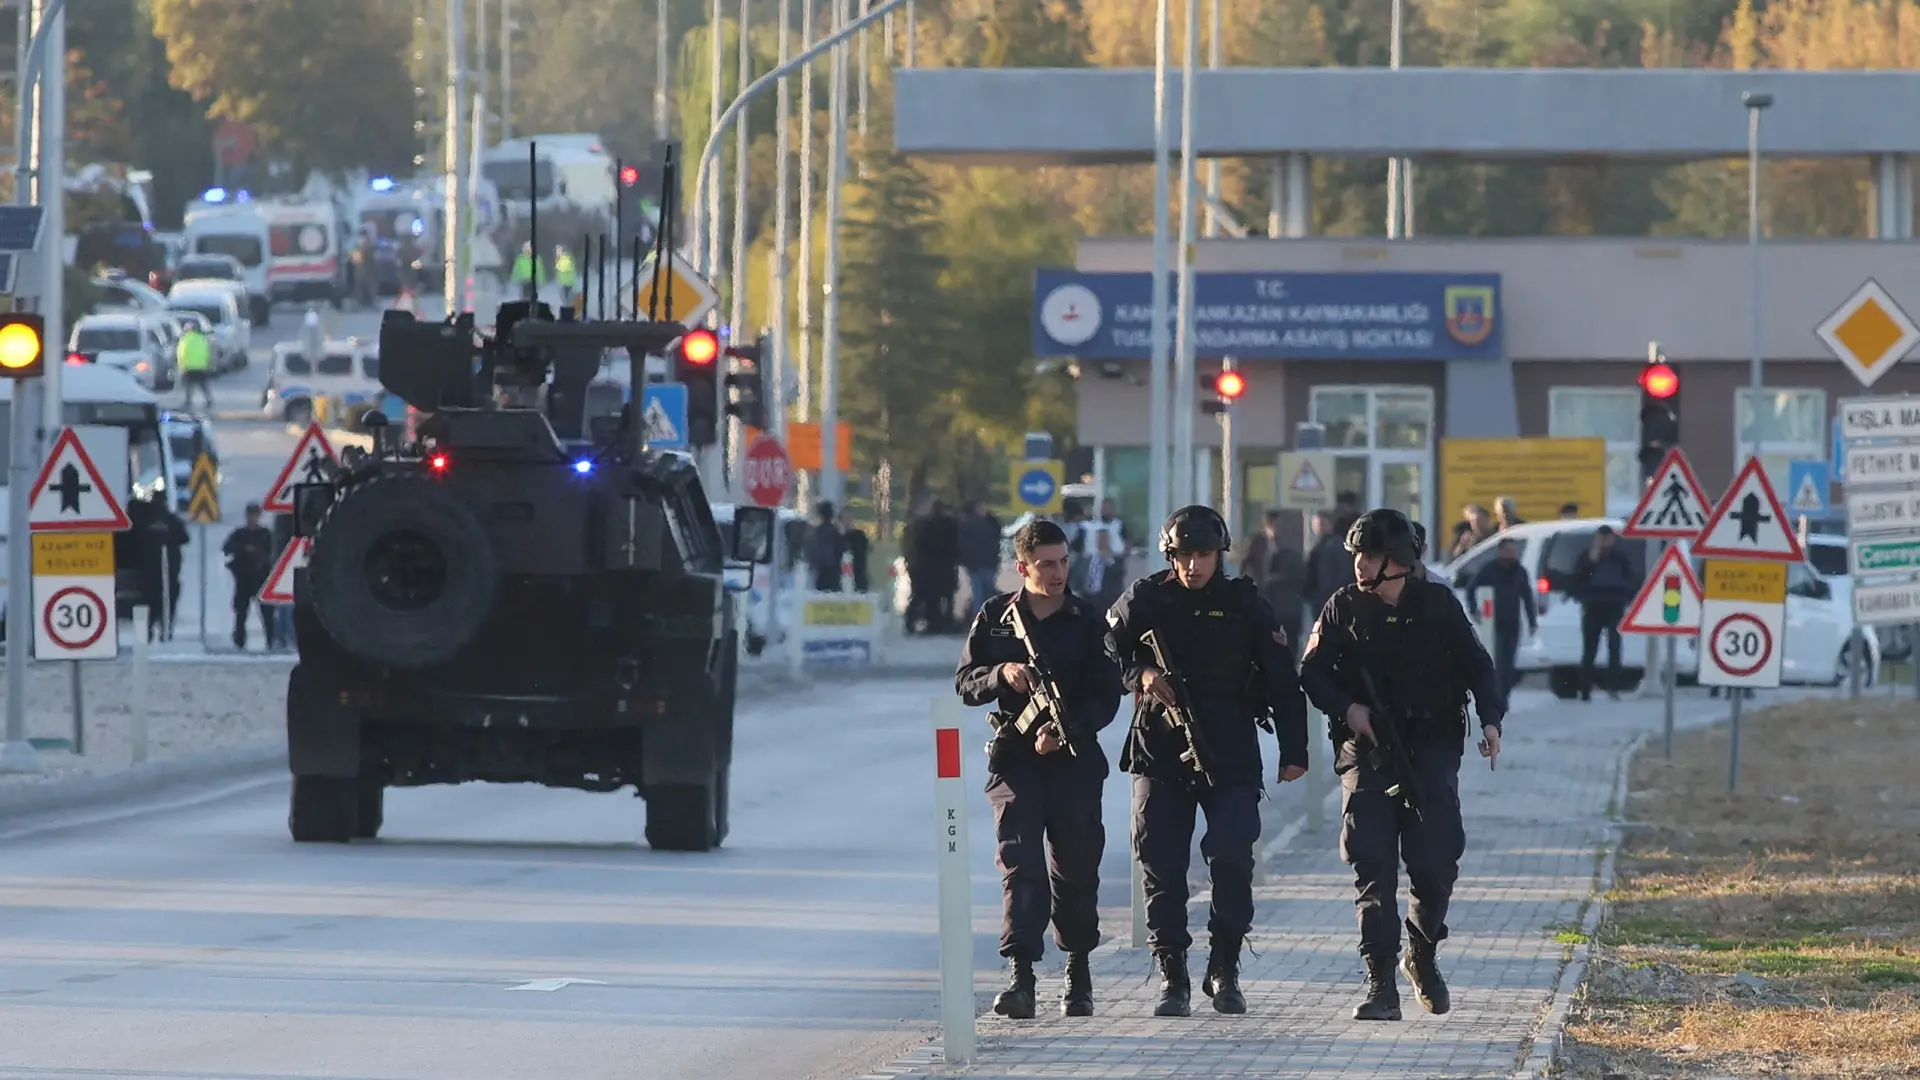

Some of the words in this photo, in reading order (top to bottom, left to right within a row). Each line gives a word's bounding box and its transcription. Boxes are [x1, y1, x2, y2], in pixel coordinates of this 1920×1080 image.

[57, 604, 92, 628] 30
[1724, 631, 1759, 657] 30
[947, 808, 957, 853] KGM
